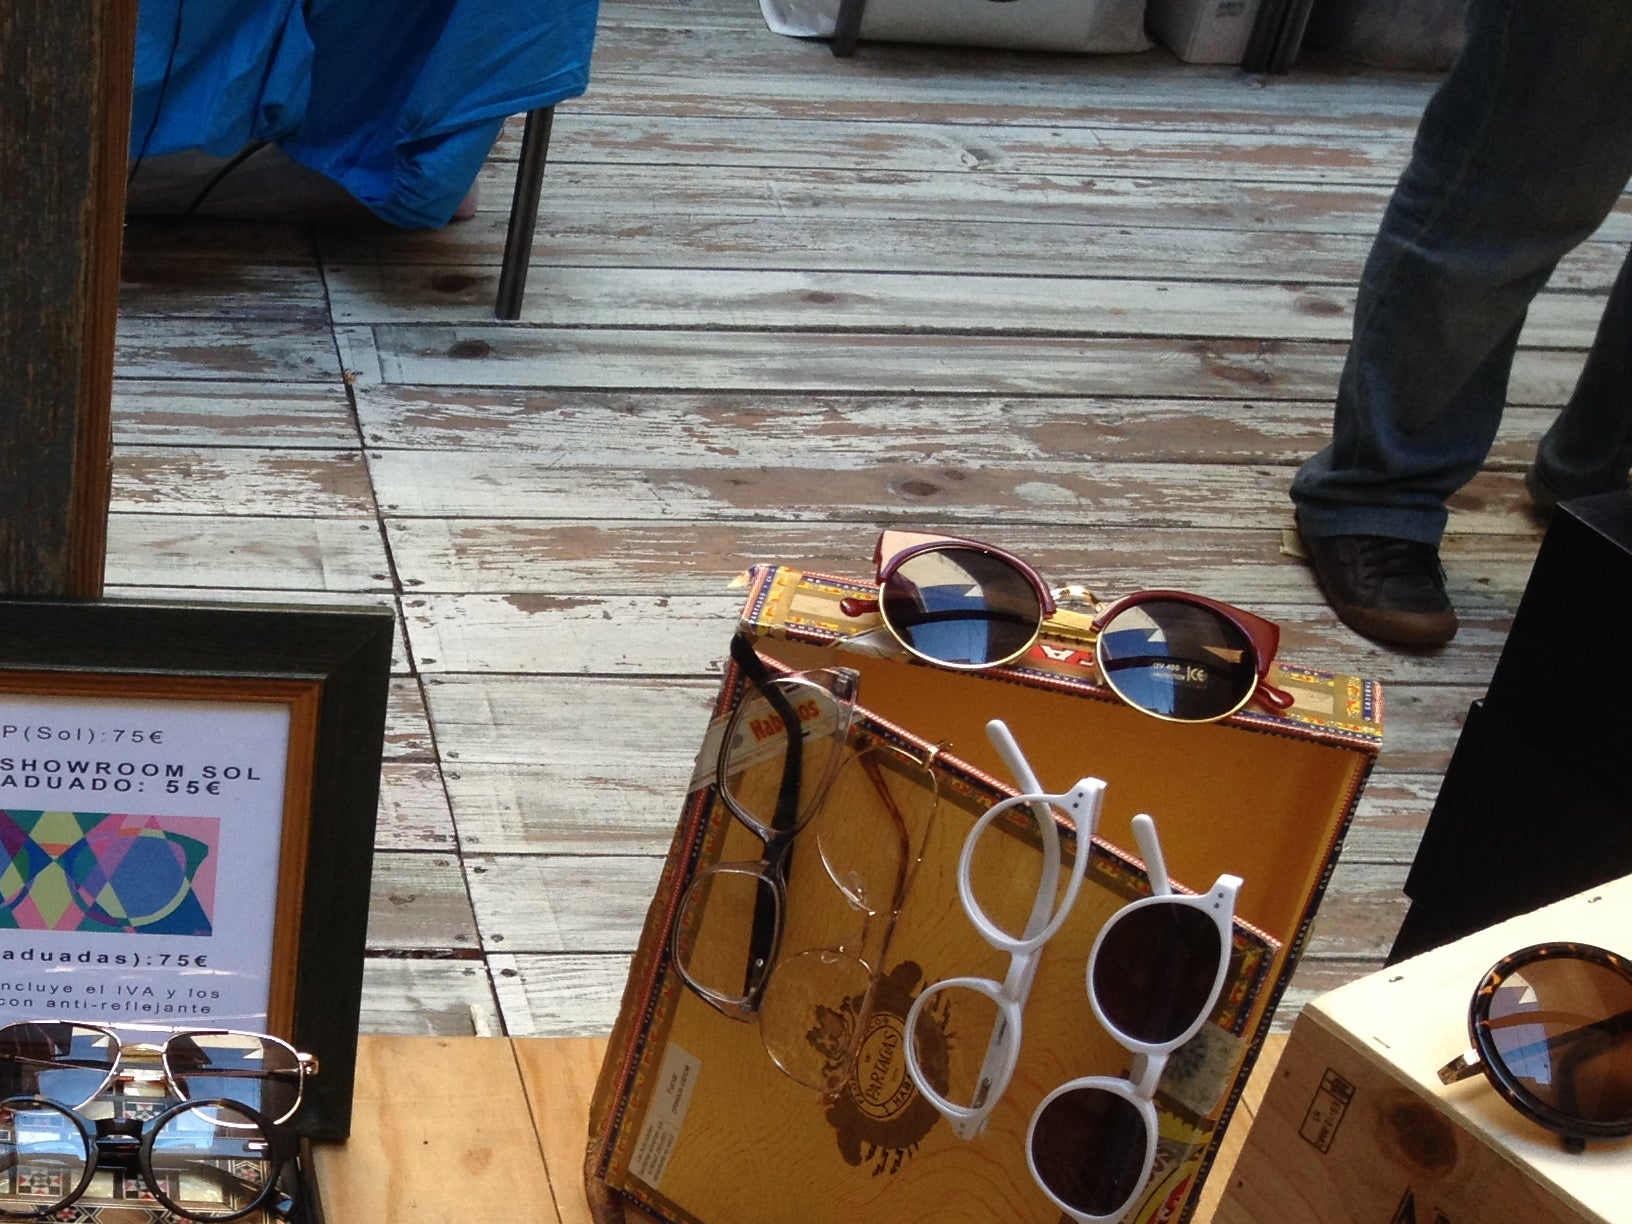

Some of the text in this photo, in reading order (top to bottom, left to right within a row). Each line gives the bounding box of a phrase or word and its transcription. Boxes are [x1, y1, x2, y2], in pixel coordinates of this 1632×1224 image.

[0, 757, 184, 778] SHOWROOM
[202, 765, 261, 781] SOL
[165, 779, 221, 796] 55€
[86, 982, 105, 994] el
[116, 984, 155, 998] IVA
[166, 988, 177, 1001] y
[188, 987, 221, 999] los
[46, 998, 212, 1015] anti-reflejante
[867, 1031, 899, 1101] PARTAGAS
